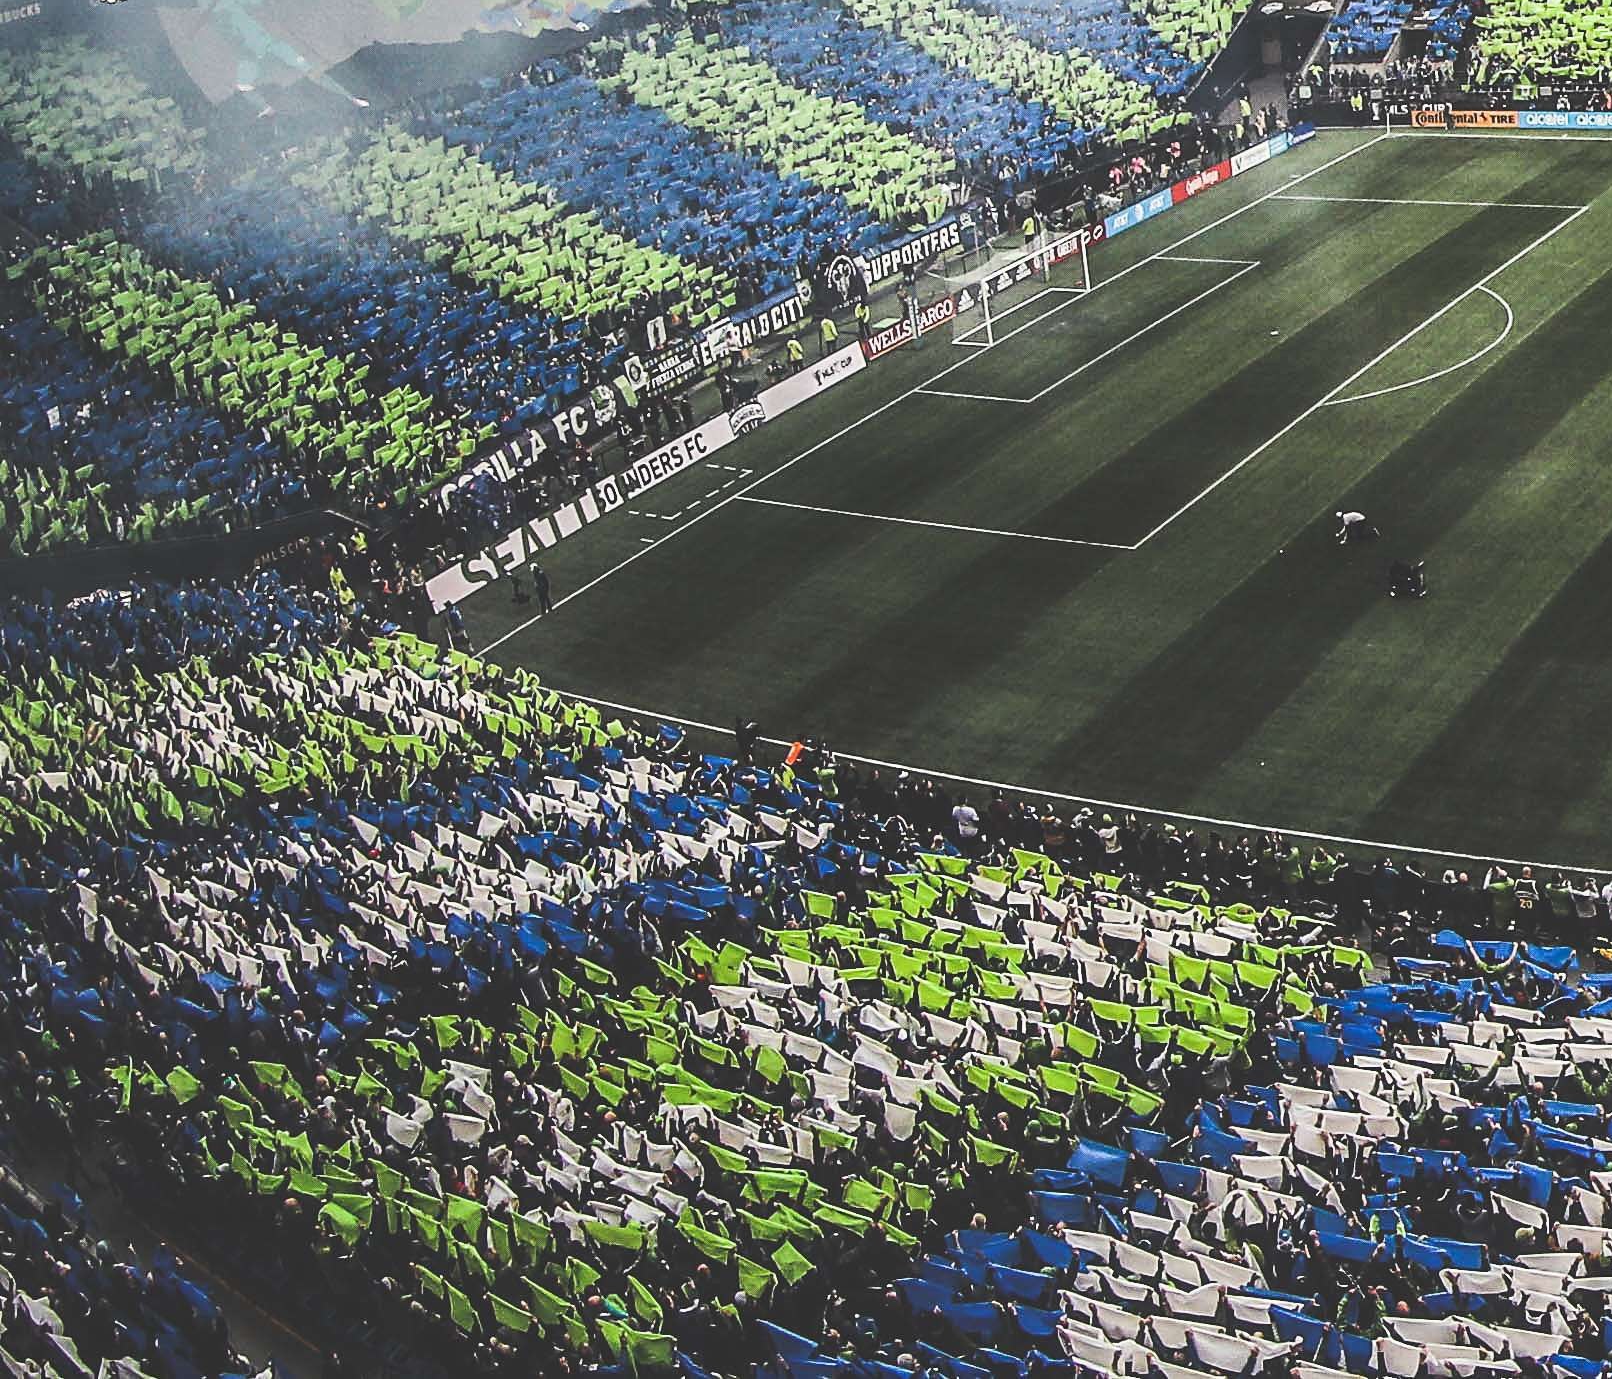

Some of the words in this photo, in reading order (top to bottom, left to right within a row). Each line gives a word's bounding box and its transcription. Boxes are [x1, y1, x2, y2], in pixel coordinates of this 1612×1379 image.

[1490, 115, 1516, 124] TIRE
[862, 222, 960, 286] SUPPORTERS
[869, 312, 913, 354] WELLS
[918, 298, 954, 331] ARGO
[552, 406, 589, 443] FC
[686, 432, 707, 461] FC
